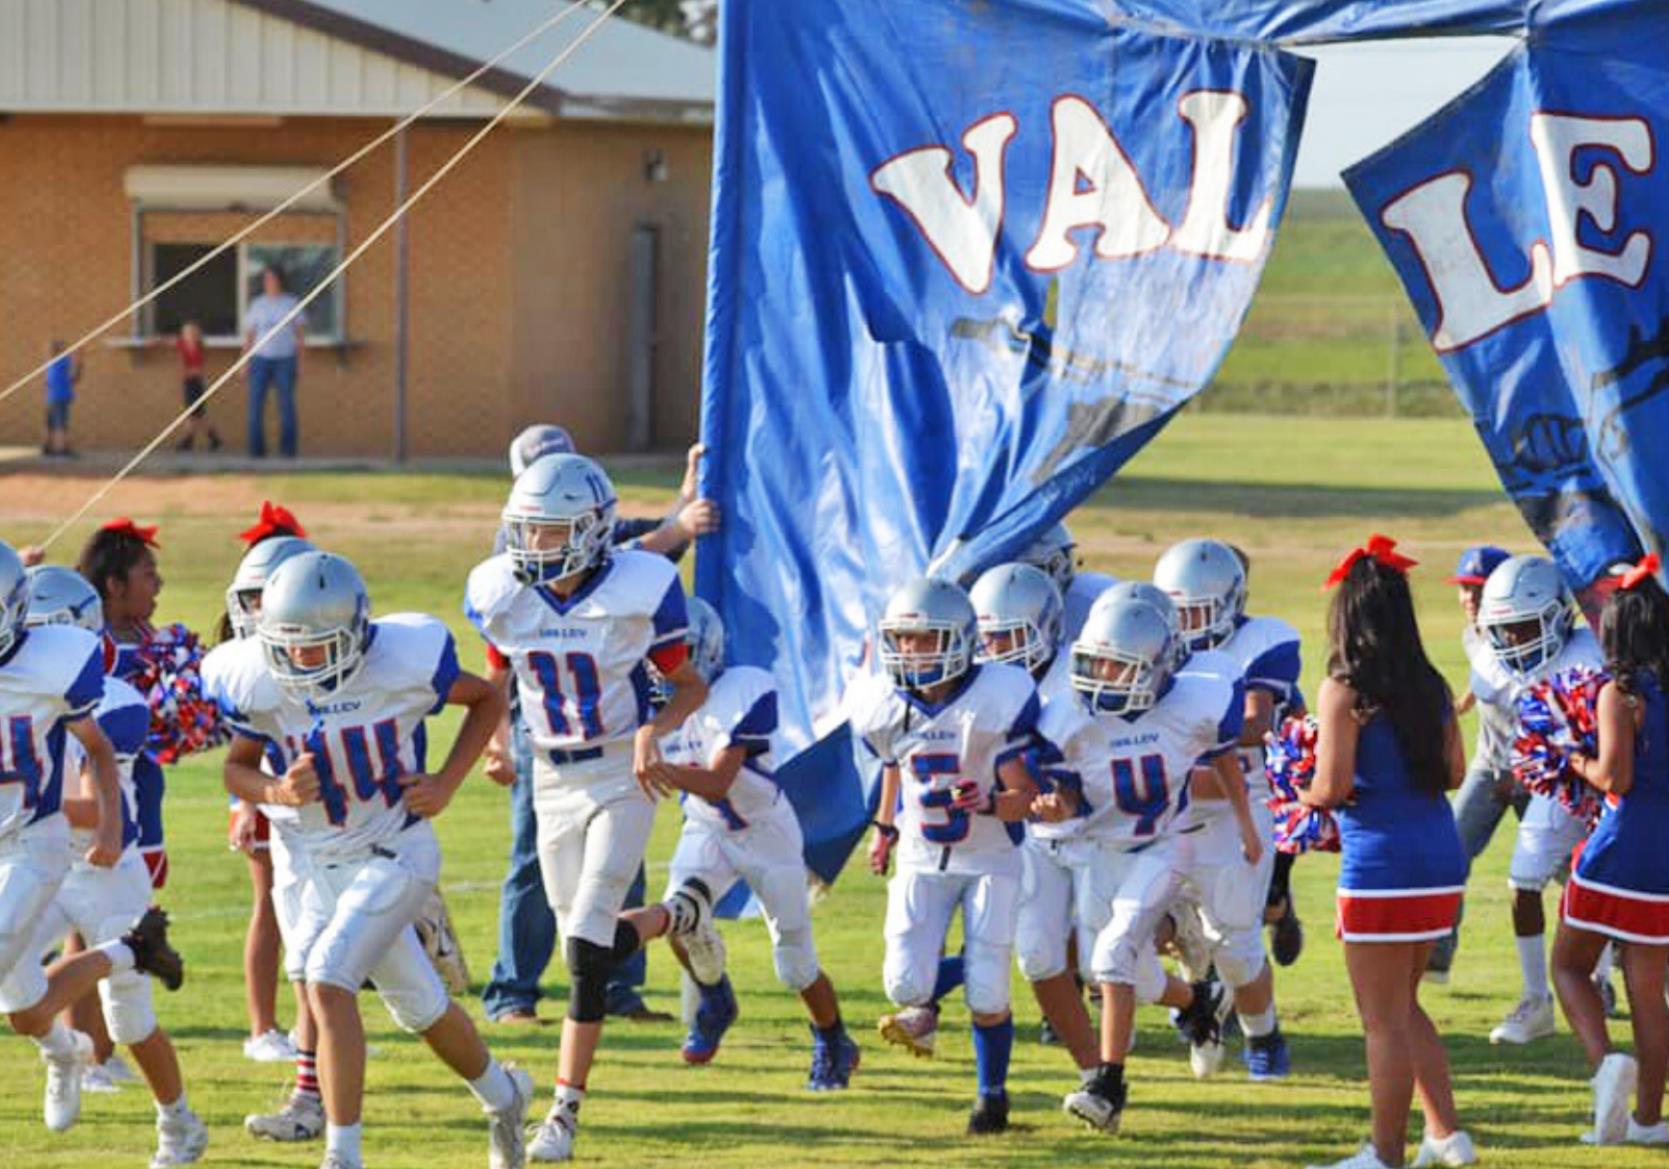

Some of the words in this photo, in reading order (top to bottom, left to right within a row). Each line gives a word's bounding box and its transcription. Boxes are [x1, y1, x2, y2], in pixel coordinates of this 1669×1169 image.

[868, 88, 1273, 295] VAL
[1378, 109, 1655, 355] LE
[528, 650, 605, 740] 11
[910, 753, 971, 843] 5
[1111, 753, 1169, 836] 4
